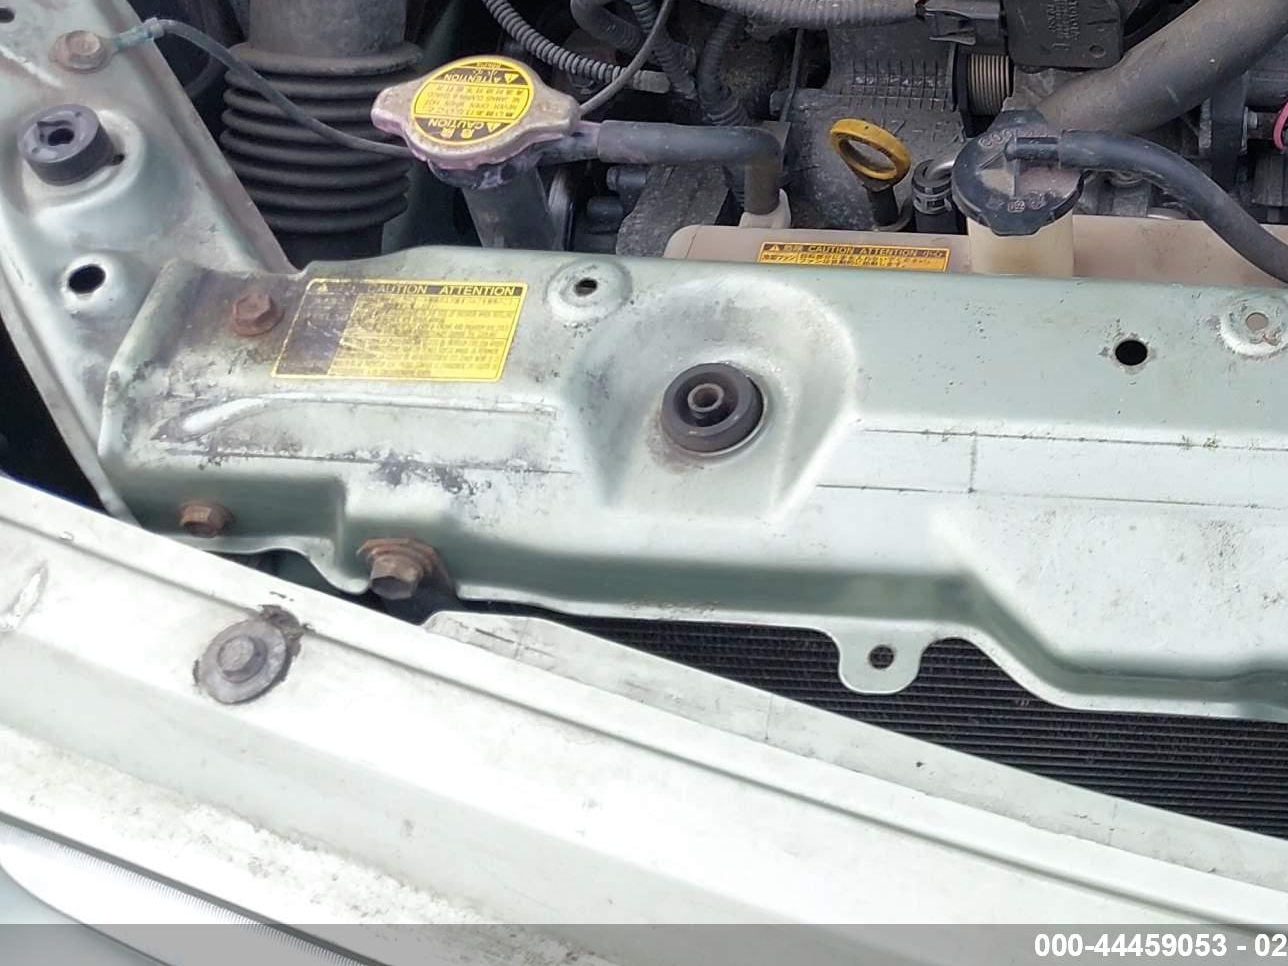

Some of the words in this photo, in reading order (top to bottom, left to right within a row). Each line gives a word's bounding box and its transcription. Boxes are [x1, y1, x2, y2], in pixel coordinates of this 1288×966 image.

[443, 73, 503, 84] ATTENTION
[428, 119, 484, 130] CAUTION
[807, 245, 855, 255] CAUTION
[859, 247, 918, 257] ATTENTION
[367, 284, 428, 295] CAUTION
[438, 285, 516, 296] ATTENTION
